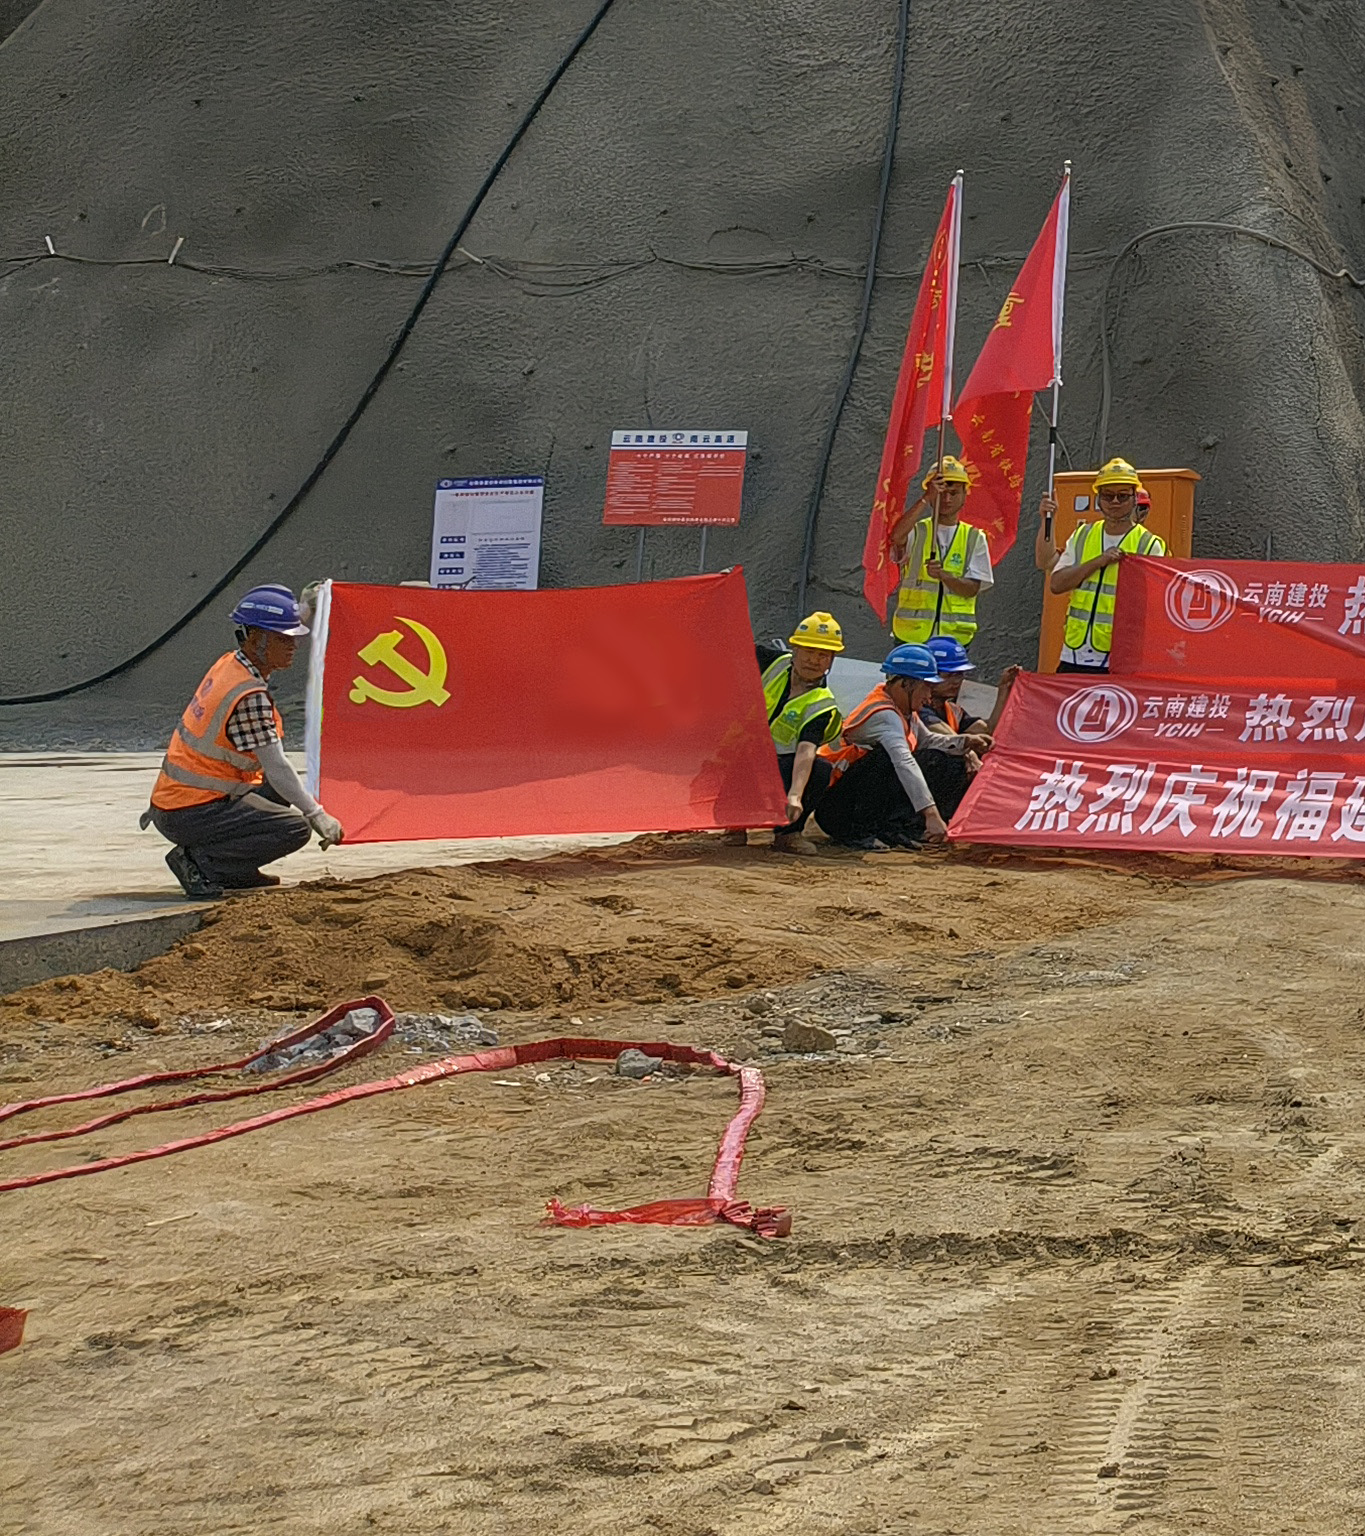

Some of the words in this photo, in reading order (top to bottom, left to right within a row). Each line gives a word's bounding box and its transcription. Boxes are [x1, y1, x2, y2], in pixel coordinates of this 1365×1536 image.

[1242, 581, 1330, 609] 云南建投
[1258, 607, 1306, 623] YCIH
[1142, 693, 1232, 720] 云南建投
[1154, 723, 1206, 737] YCIH
